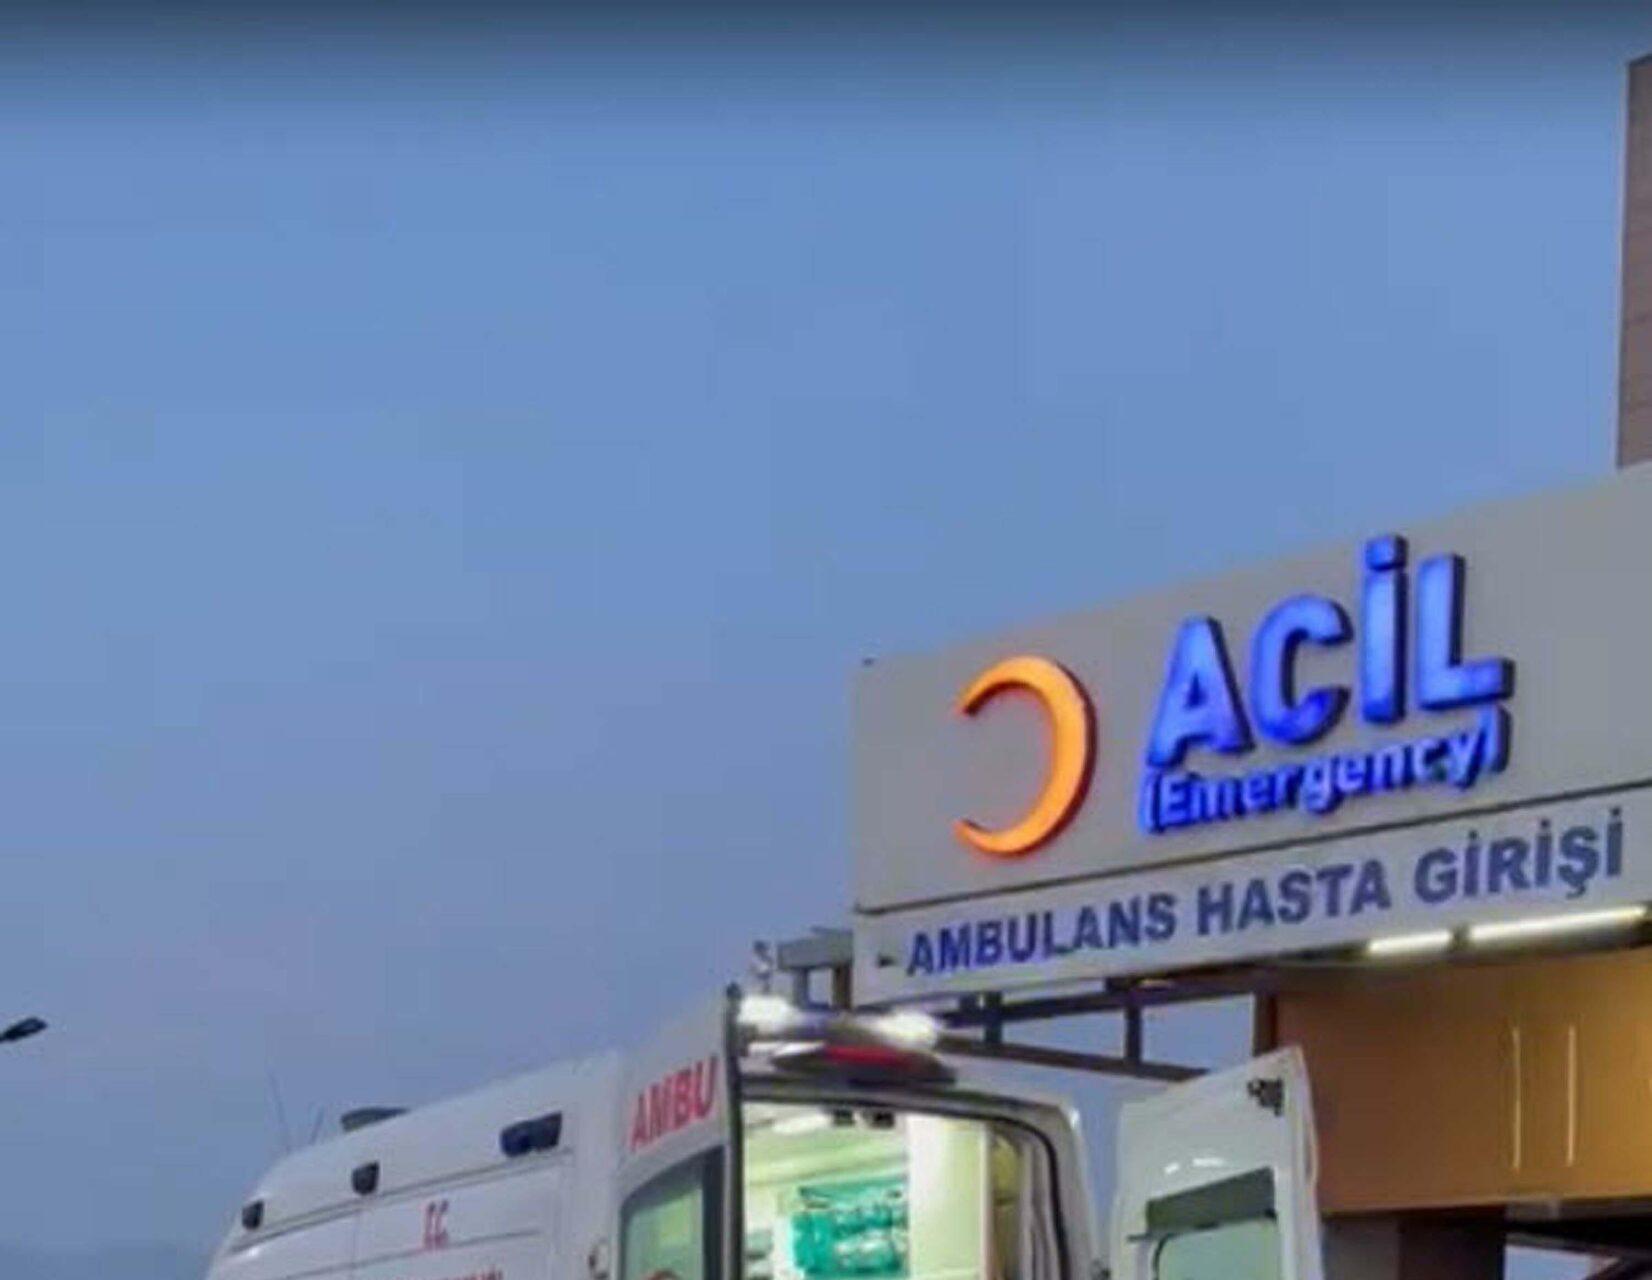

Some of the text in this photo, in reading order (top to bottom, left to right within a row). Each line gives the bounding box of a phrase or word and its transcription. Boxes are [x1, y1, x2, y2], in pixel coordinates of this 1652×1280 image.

[1146, 533, 1516, 768] ACİL
[1138, 702, 1512, 834] (Emergency)
[907, 806, 1625, 977] AMBULANS HASTA GİRİŞİ
[629, 1054, 718, 1153] AMBU
